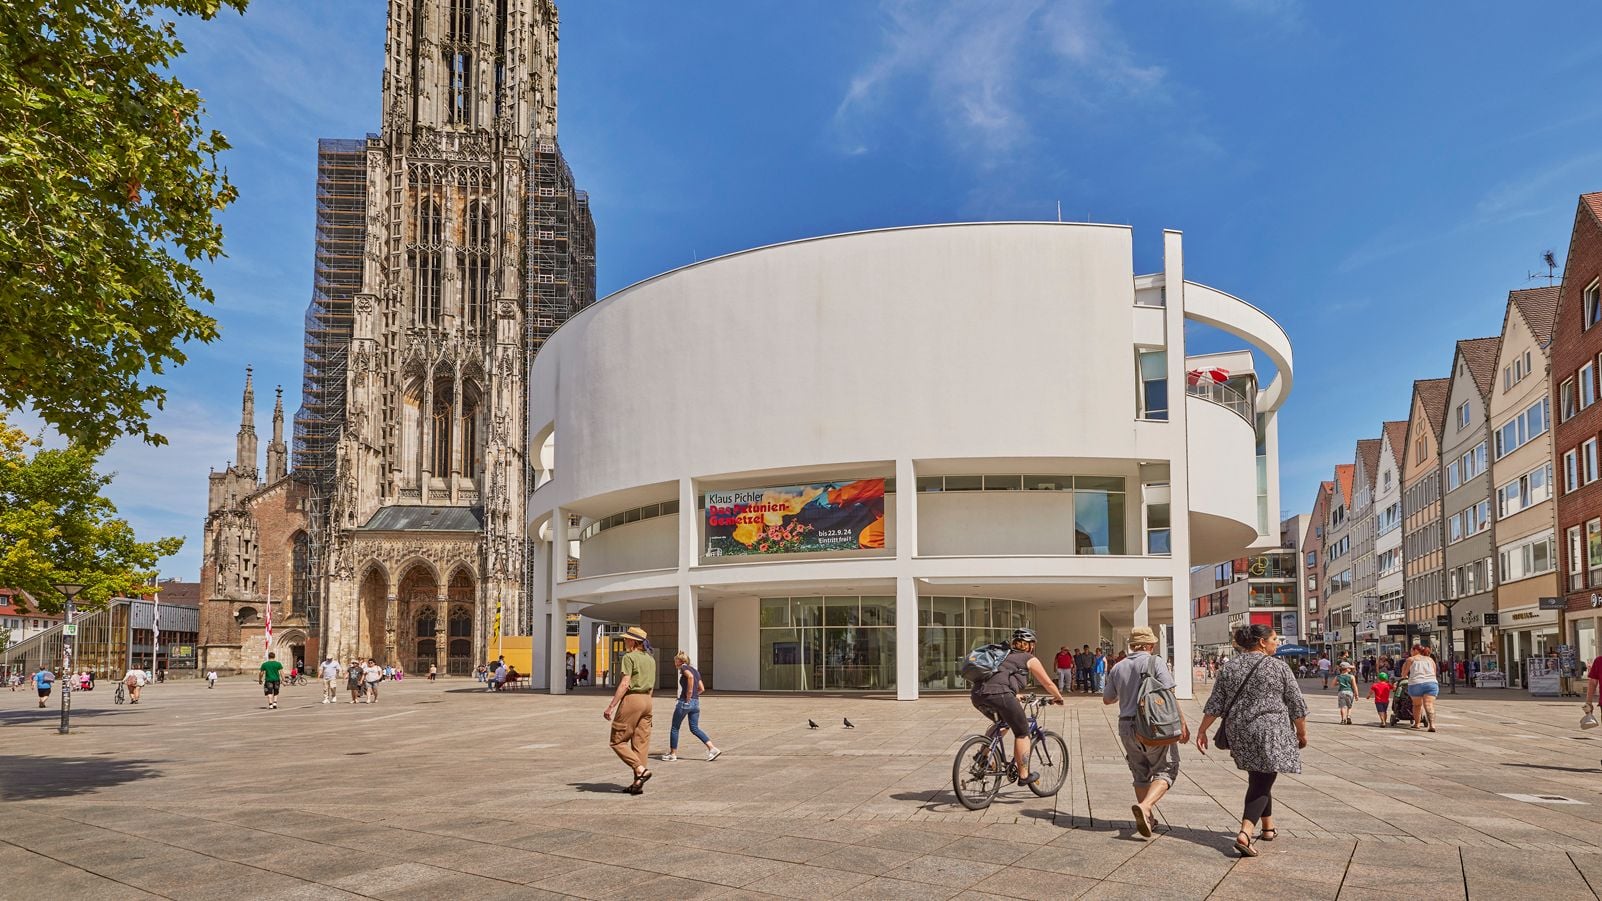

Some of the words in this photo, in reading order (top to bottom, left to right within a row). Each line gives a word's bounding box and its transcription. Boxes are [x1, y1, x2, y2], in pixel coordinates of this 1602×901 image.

[709, 494, 732, 504] Klaus
[735, 492, 763, 503] Pichler
[709, 505, 731, 514] Das
[709, 514, 764, 526] Gemetzel
